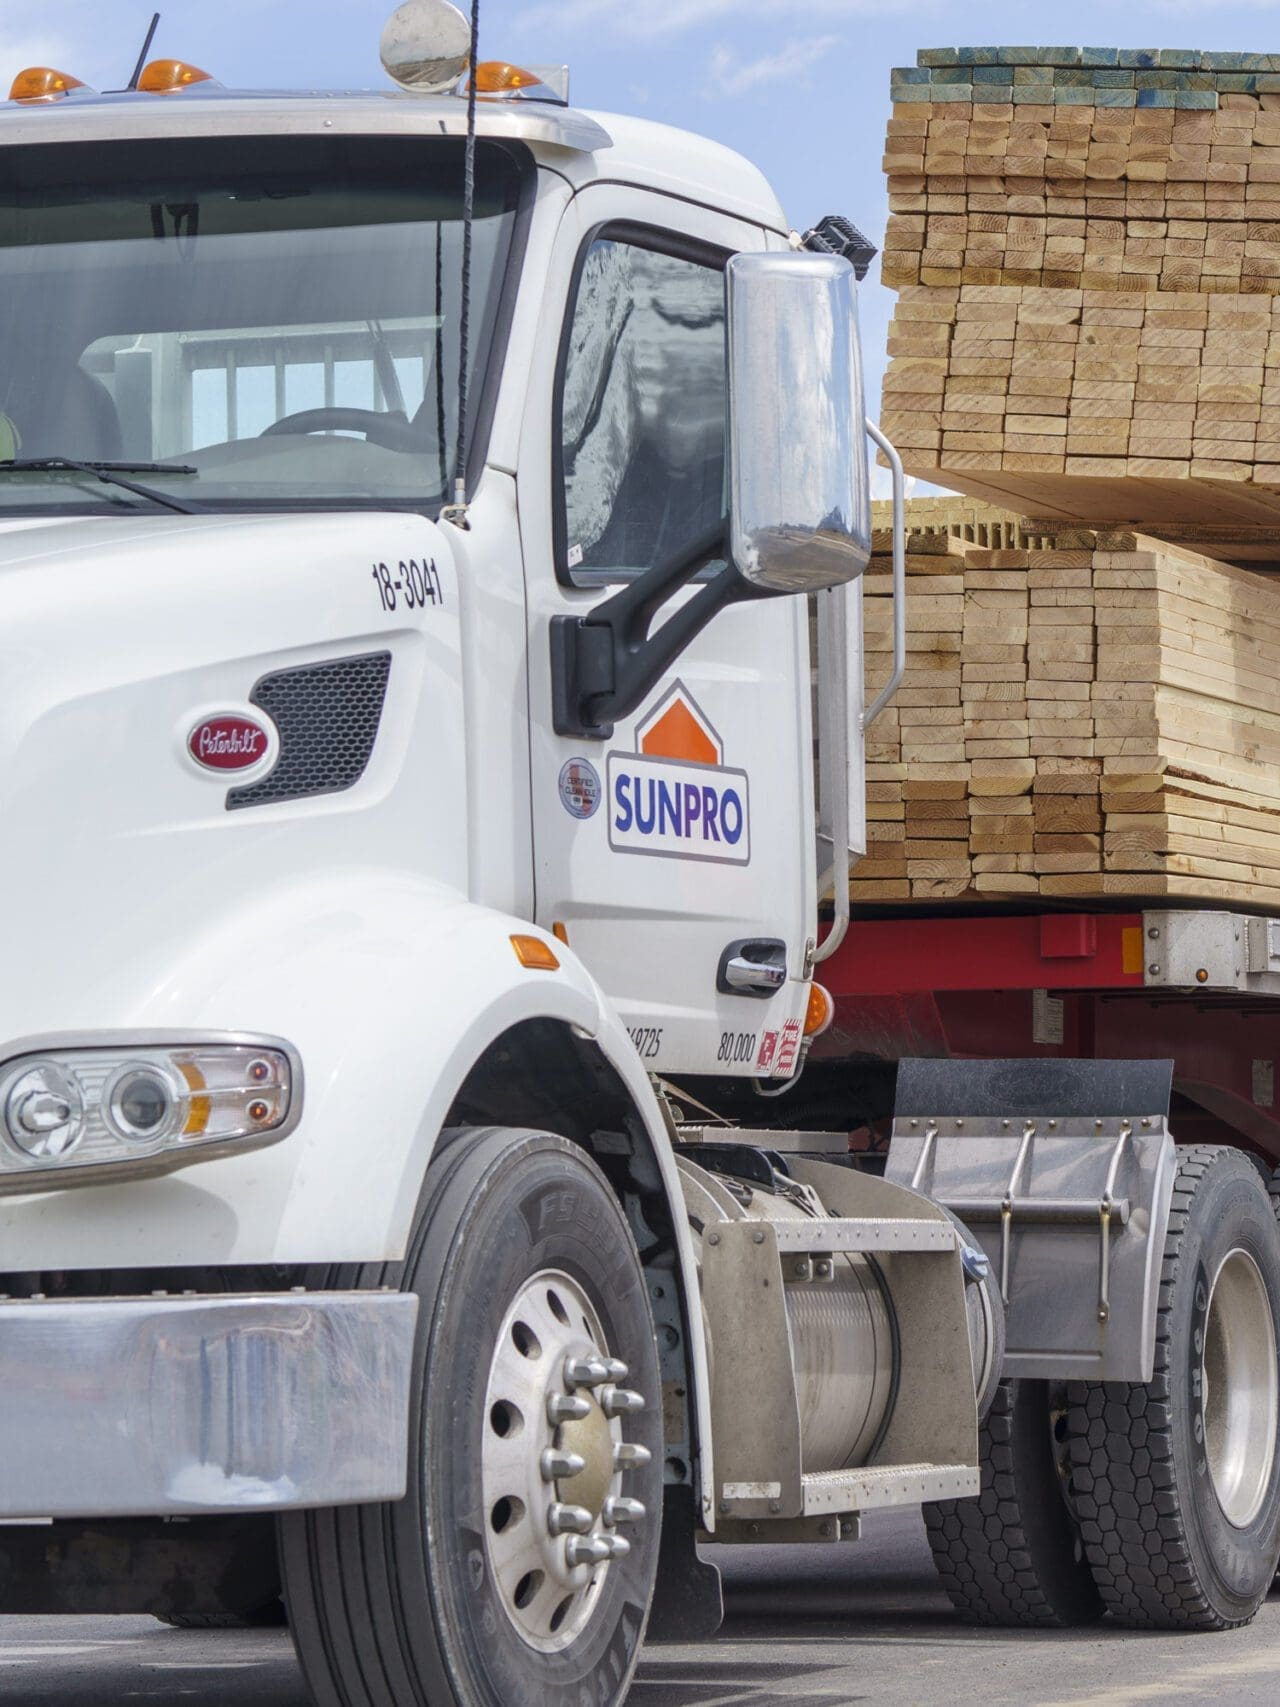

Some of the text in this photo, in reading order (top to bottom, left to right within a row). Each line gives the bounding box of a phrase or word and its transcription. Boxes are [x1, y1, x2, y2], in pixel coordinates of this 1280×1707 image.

[372, 558, 443, 611] 18-3041
[200, 726, 262, 757] Peterbilt
[615, 773, 743, 845] SUNPRO
[717, 1031, 756, 1067] 80,000
